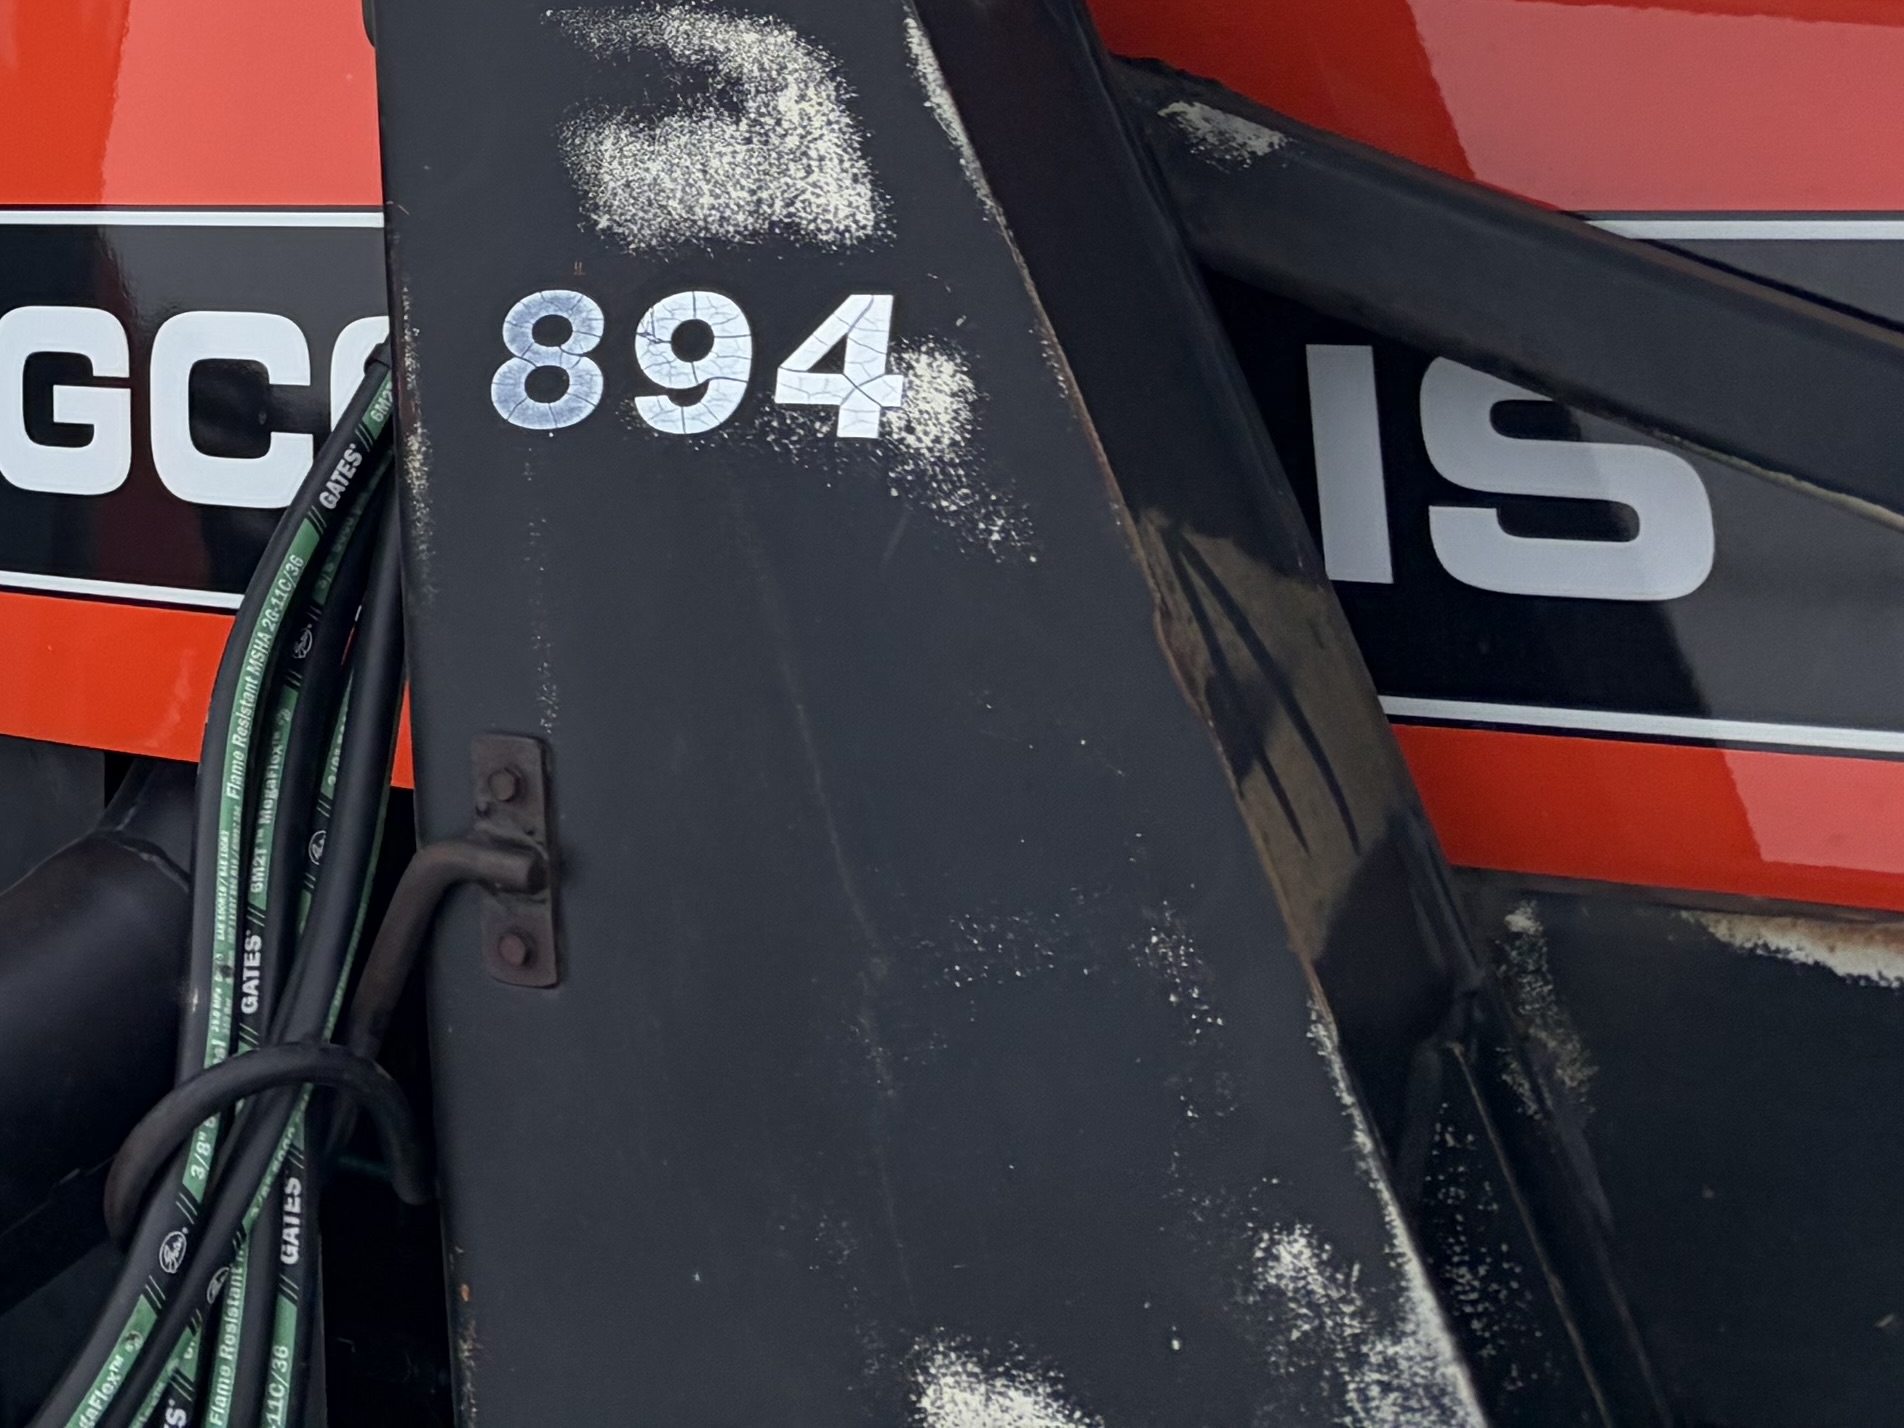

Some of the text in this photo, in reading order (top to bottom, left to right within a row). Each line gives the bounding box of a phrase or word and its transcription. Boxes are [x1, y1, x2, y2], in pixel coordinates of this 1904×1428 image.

[491, 289, 904, 439] 894
[247, 632, 273, 675] MSHA
[232, 675, 260, 747] Resistant
[225, 748, 246, 800] Flame
[208, 1365, 232, 1427] Flame
